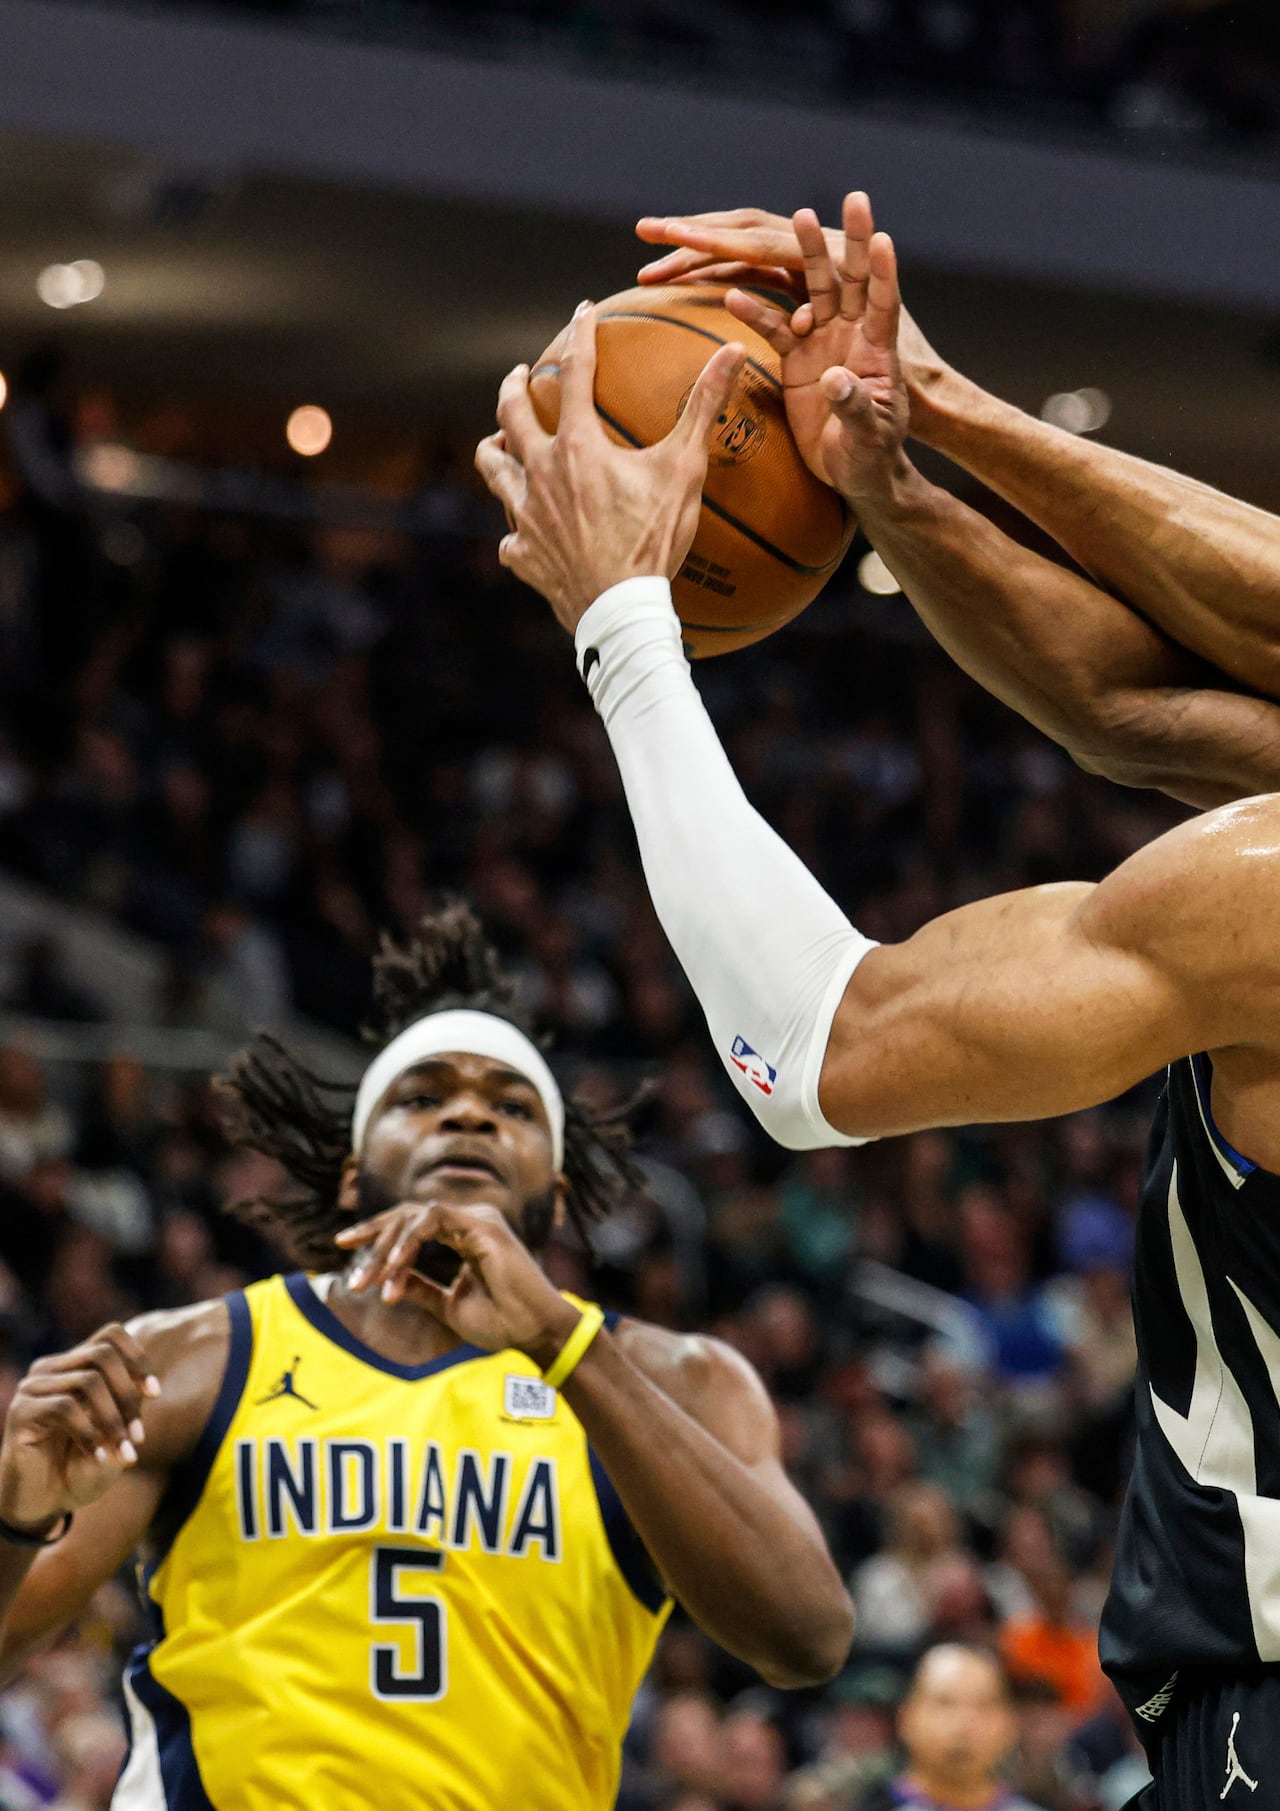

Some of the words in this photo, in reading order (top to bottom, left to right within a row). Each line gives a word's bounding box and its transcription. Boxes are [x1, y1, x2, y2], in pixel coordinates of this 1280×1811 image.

[236, 1437, 562, 1564] INDIANA
[370, 1543, 449, 1704] 5
[1134, 1692, 1174, 1723] FEAR
